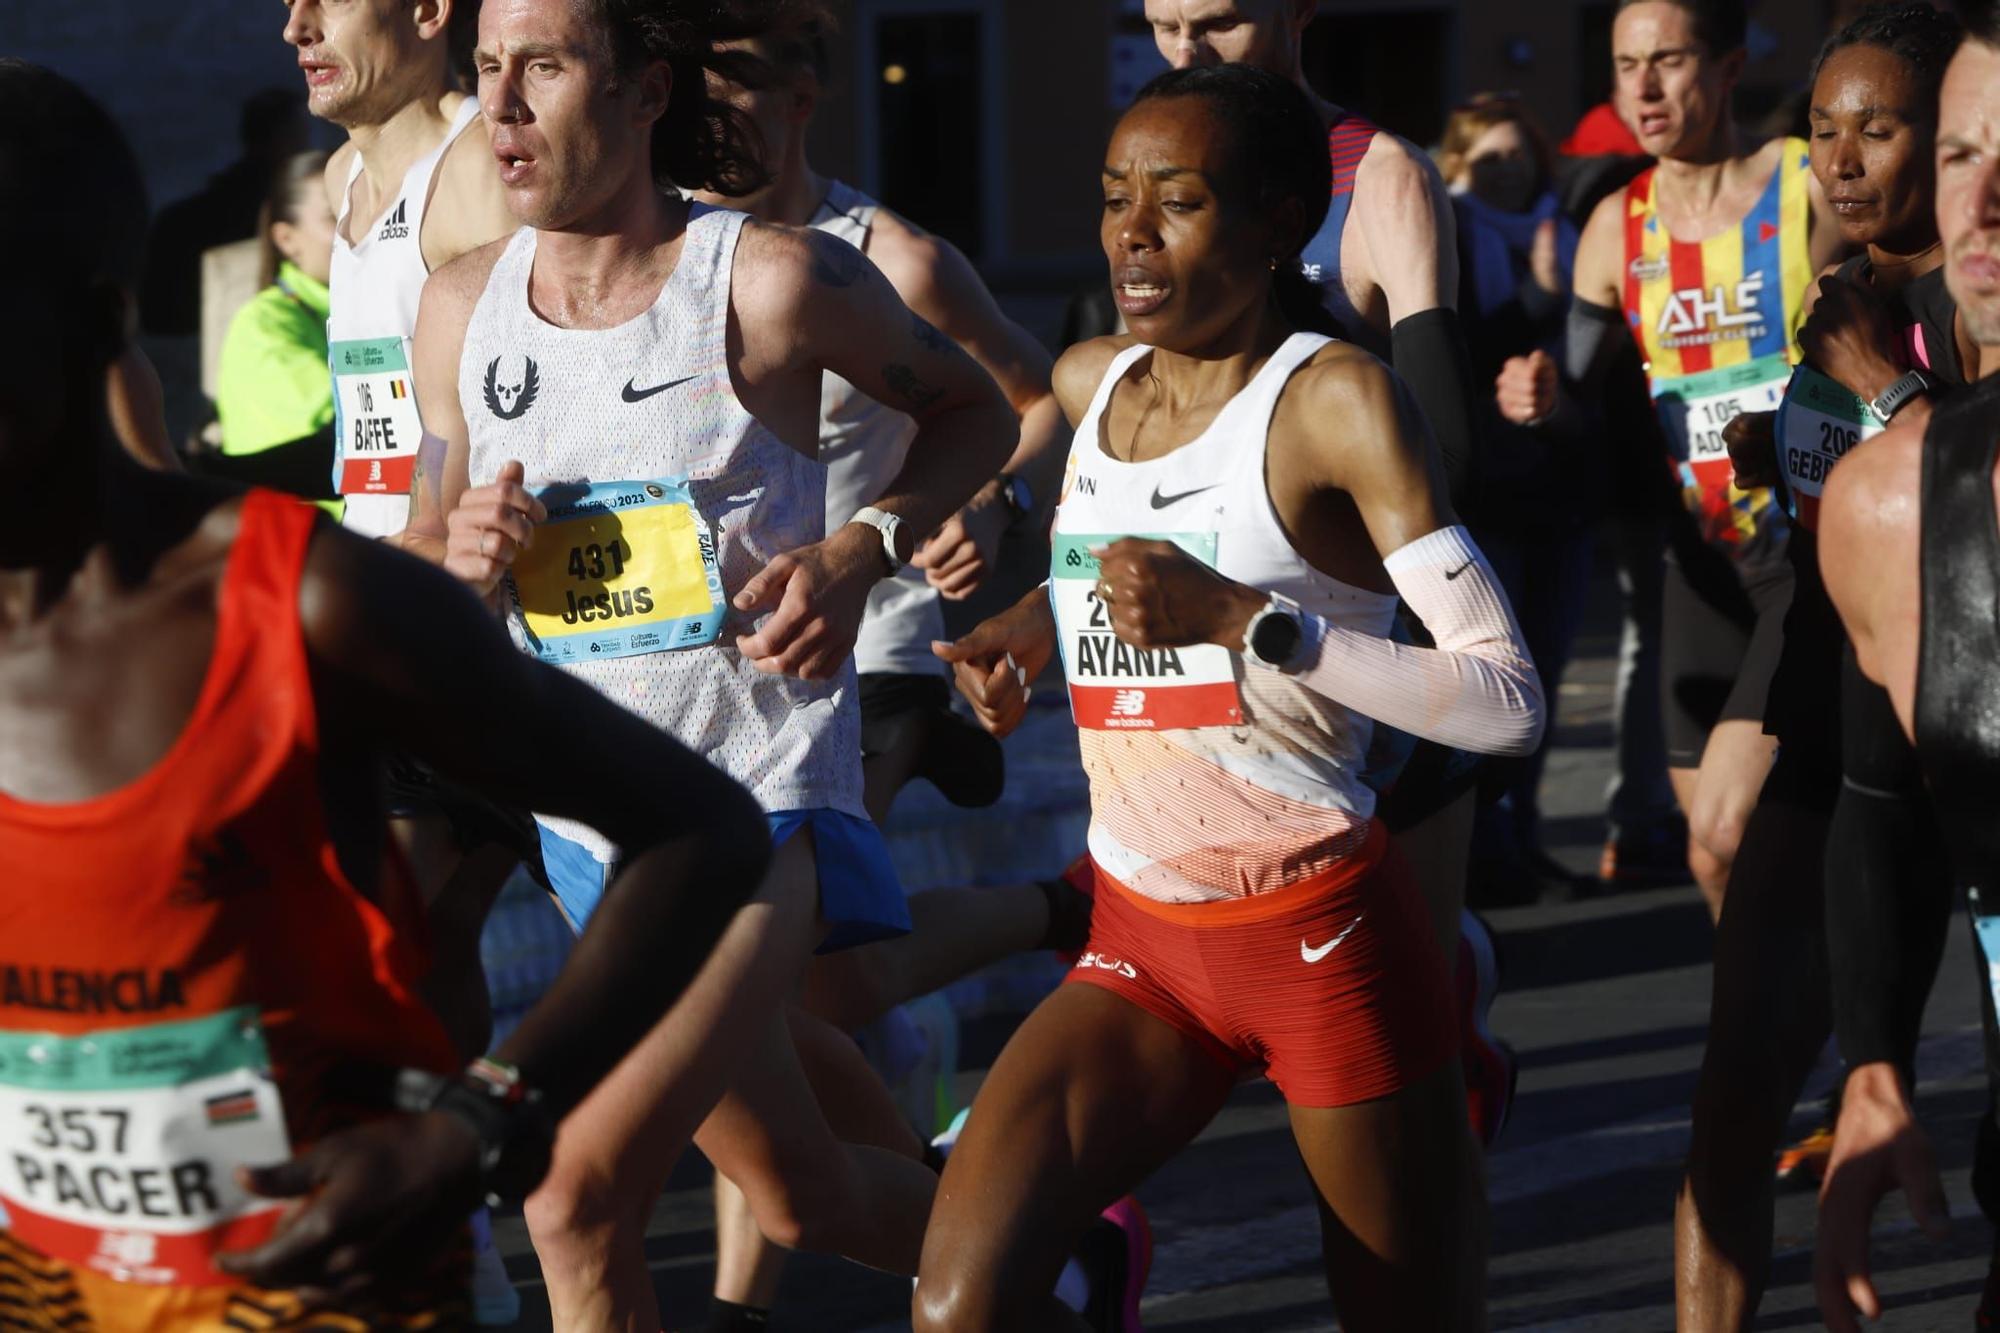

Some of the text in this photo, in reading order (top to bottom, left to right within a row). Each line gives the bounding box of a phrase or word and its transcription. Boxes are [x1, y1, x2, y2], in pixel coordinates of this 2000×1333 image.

[357, 382, 374, 413] 106
[354, 417, 398, 451] BAFFE
[1695, 430, 1722, 454] AD
[1788, 447, 1835, 485] GEBR
[618, 494, 645, 507] 2023
[1075, 474, 1097, 496] NN
[568, 540, 625, 581] 431
[561, 586, 655, 625] Jesus
[1087, 590, 1112, 627] 2
[632, 639, 660, 649] Esfuerzo
[1078, 635, 1185, 677] AYANA
[0, 966, 185, 1013] ALENCIA
[25, 1105, 130, 1155] 357
[14, 1153, 220, 1217] PACER
